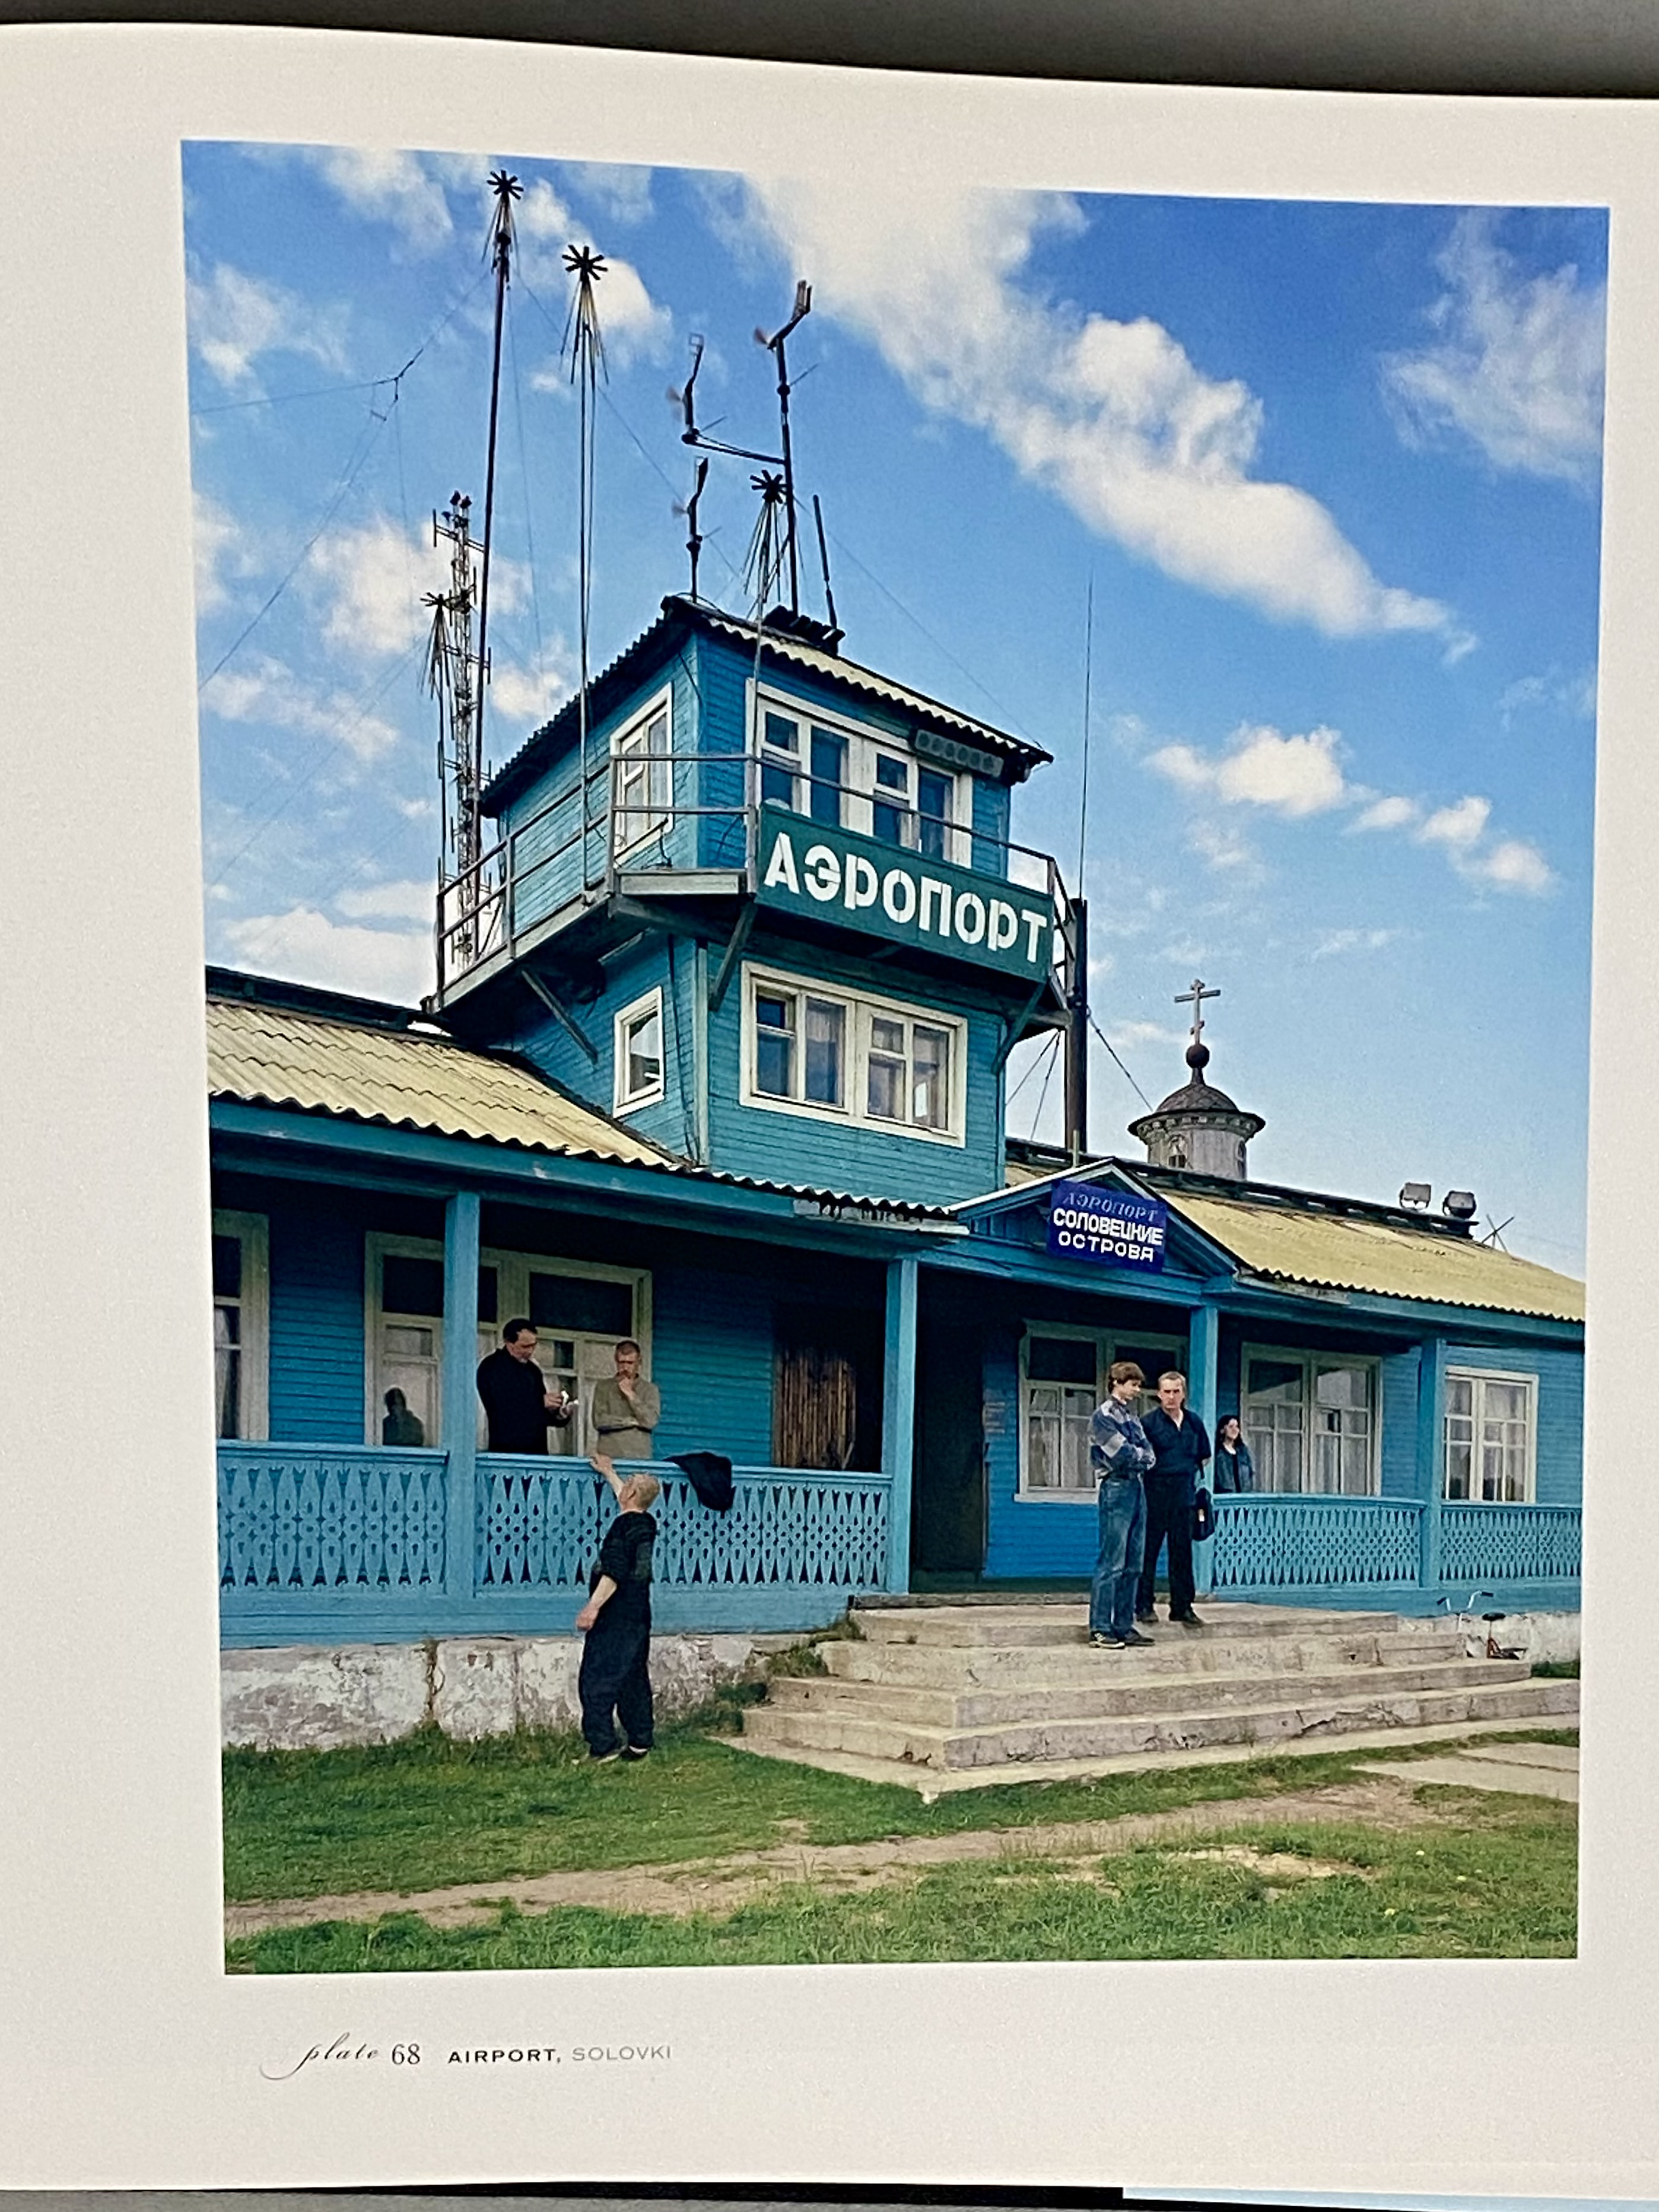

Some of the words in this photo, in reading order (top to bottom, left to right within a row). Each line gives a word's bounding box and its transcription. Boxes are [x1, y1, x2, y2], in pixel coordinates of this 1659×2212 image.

[764, 832, 1047, 964] АЭРОПОРТ
[1053, 1207, 1164, 1246] СОЛОВЕЦКИЕ
[1062, 1192, 1158, 1222] АЭРОПОРТ
[1058, 1231, 1155, 1263] ОСТРОВА
[259, 2032, 379, 2080] plate
[391, 2043, 421, 2065] 68
[447, 2048, 562, 2063] AIRPORT,
[571, 2045, 672, 2062] SOLOVKI
